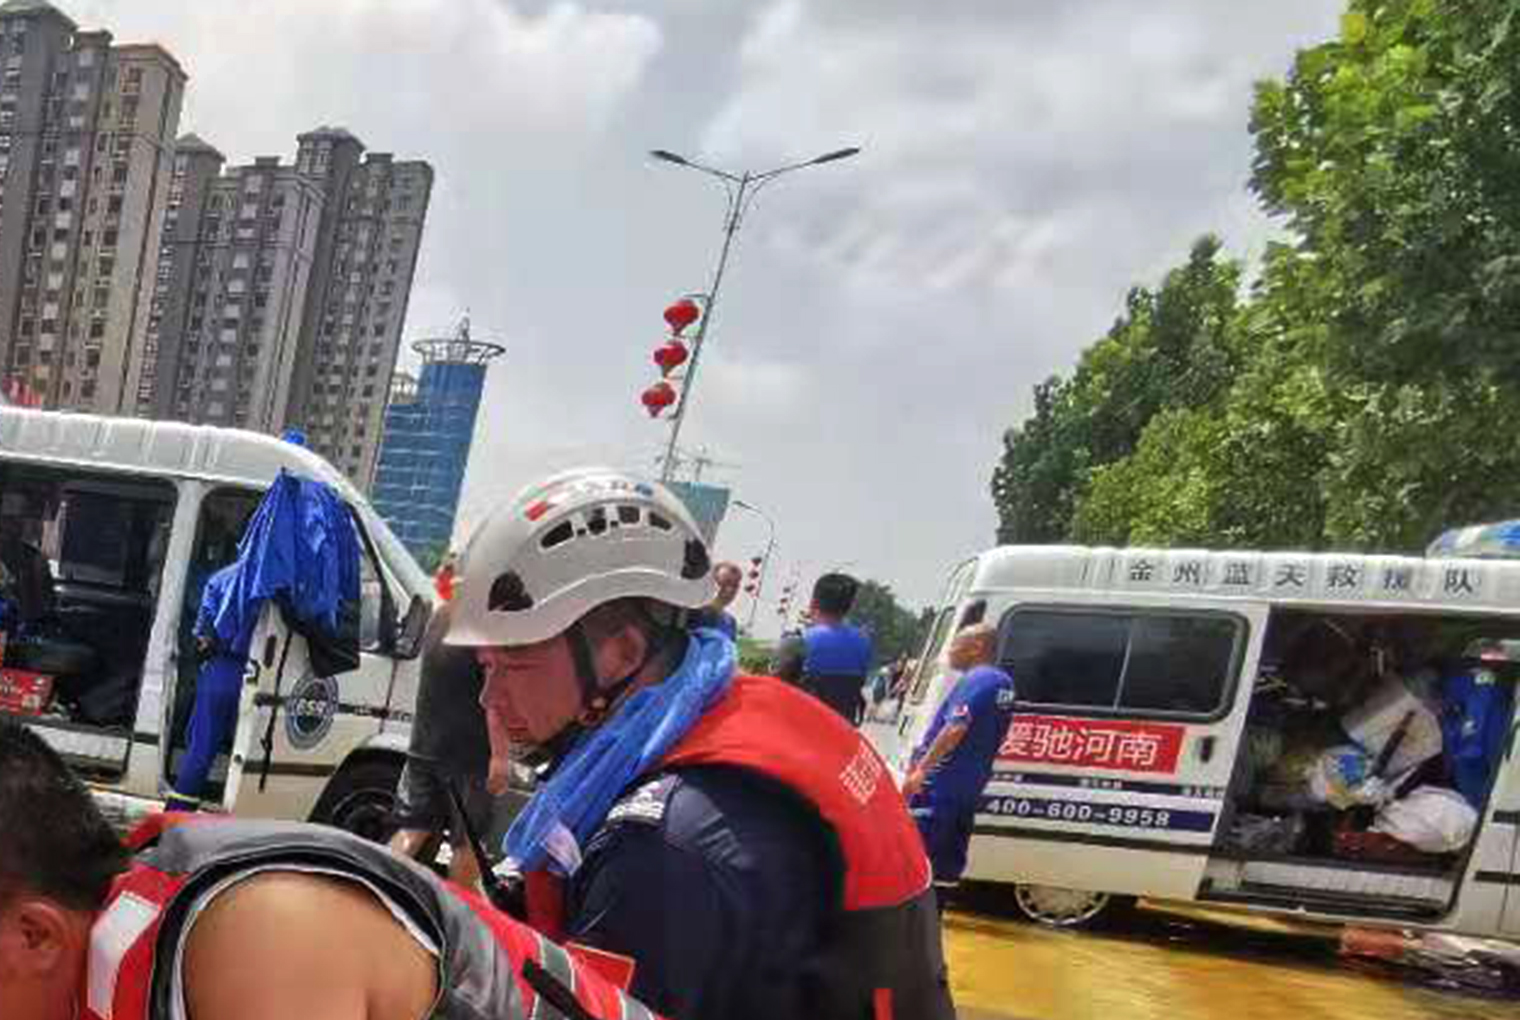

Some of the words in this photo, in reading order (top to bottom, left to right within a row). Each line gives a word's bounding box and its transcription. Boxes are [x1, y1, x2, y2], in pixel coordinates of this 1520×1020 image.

[1128, 558, 1474, 594] 金州蓝天救援队
[986, 798, 1171, 827] 400-600-9958
